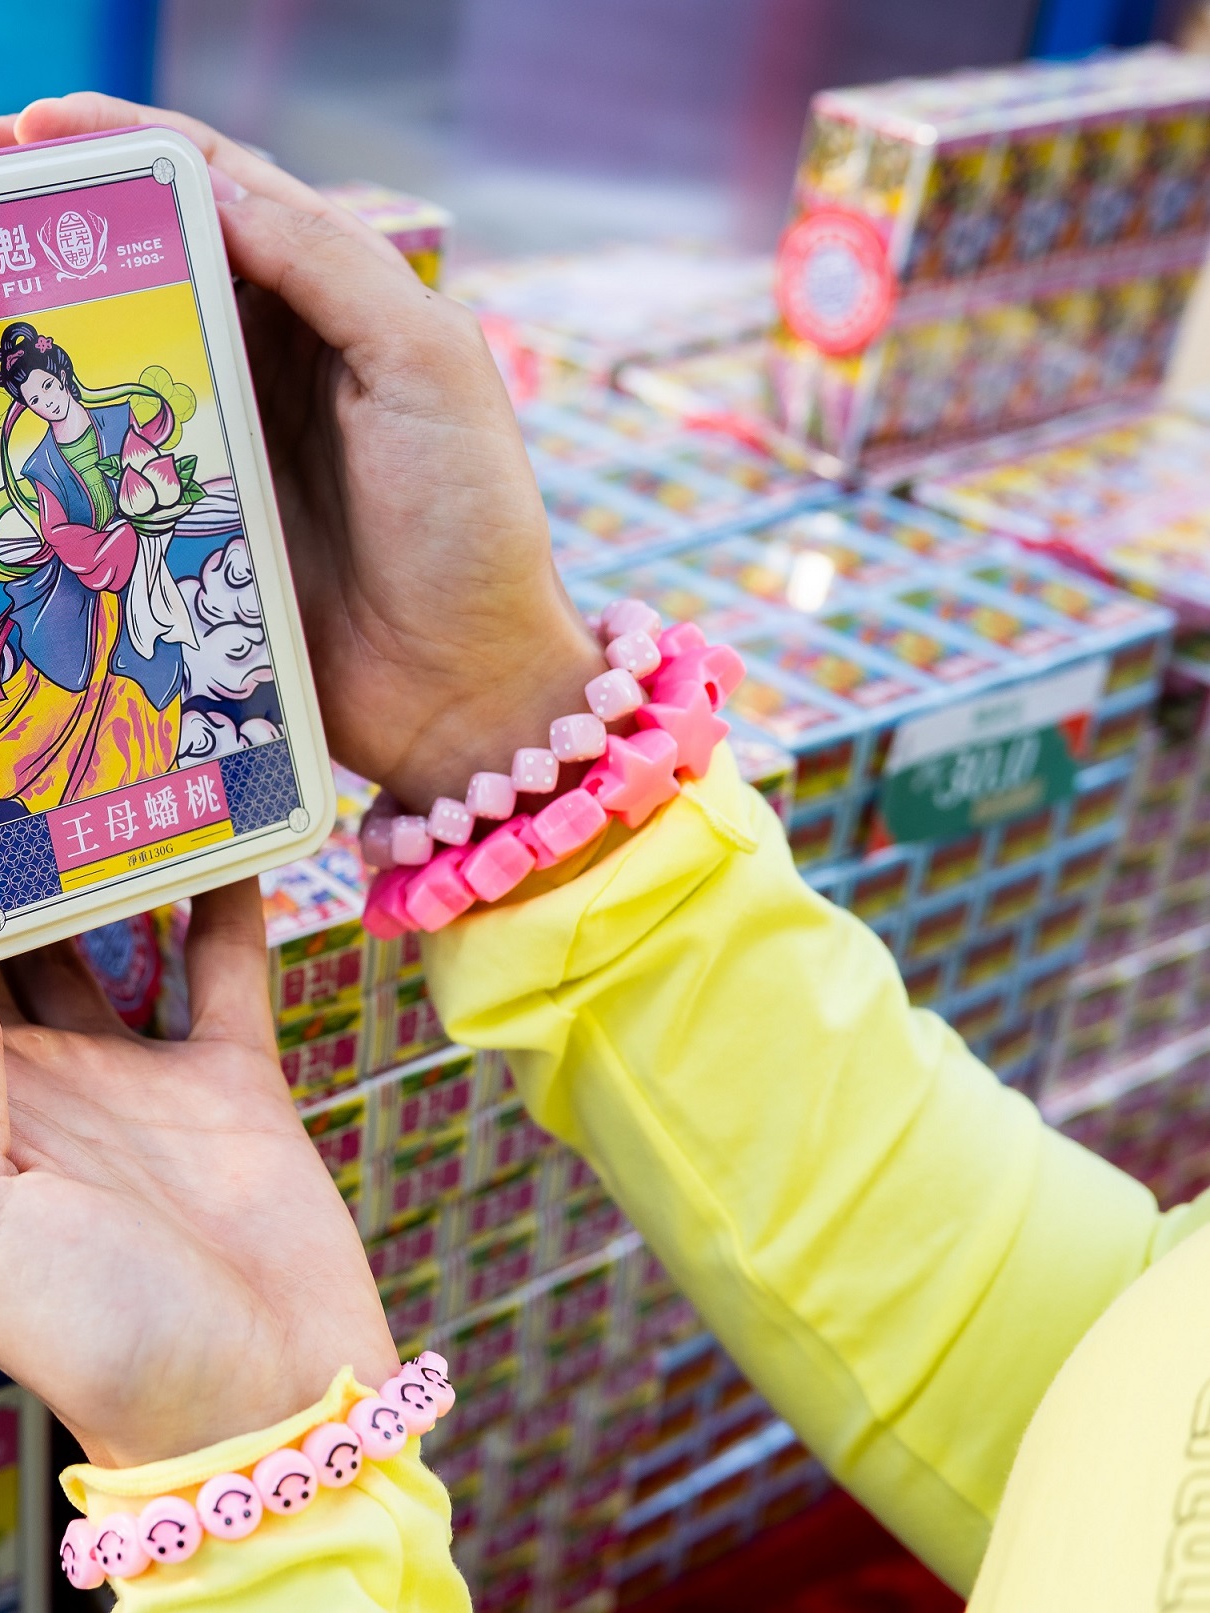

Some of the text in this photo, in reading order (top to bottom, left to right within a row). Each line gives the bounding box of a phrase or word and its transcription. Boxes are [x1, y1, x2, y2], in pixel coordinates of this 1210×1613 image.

[116, 238, 163, 256] SINCE
[2, 276, 42, 298] FUI
[61, 774, 222, 859] 王母蟠桃
